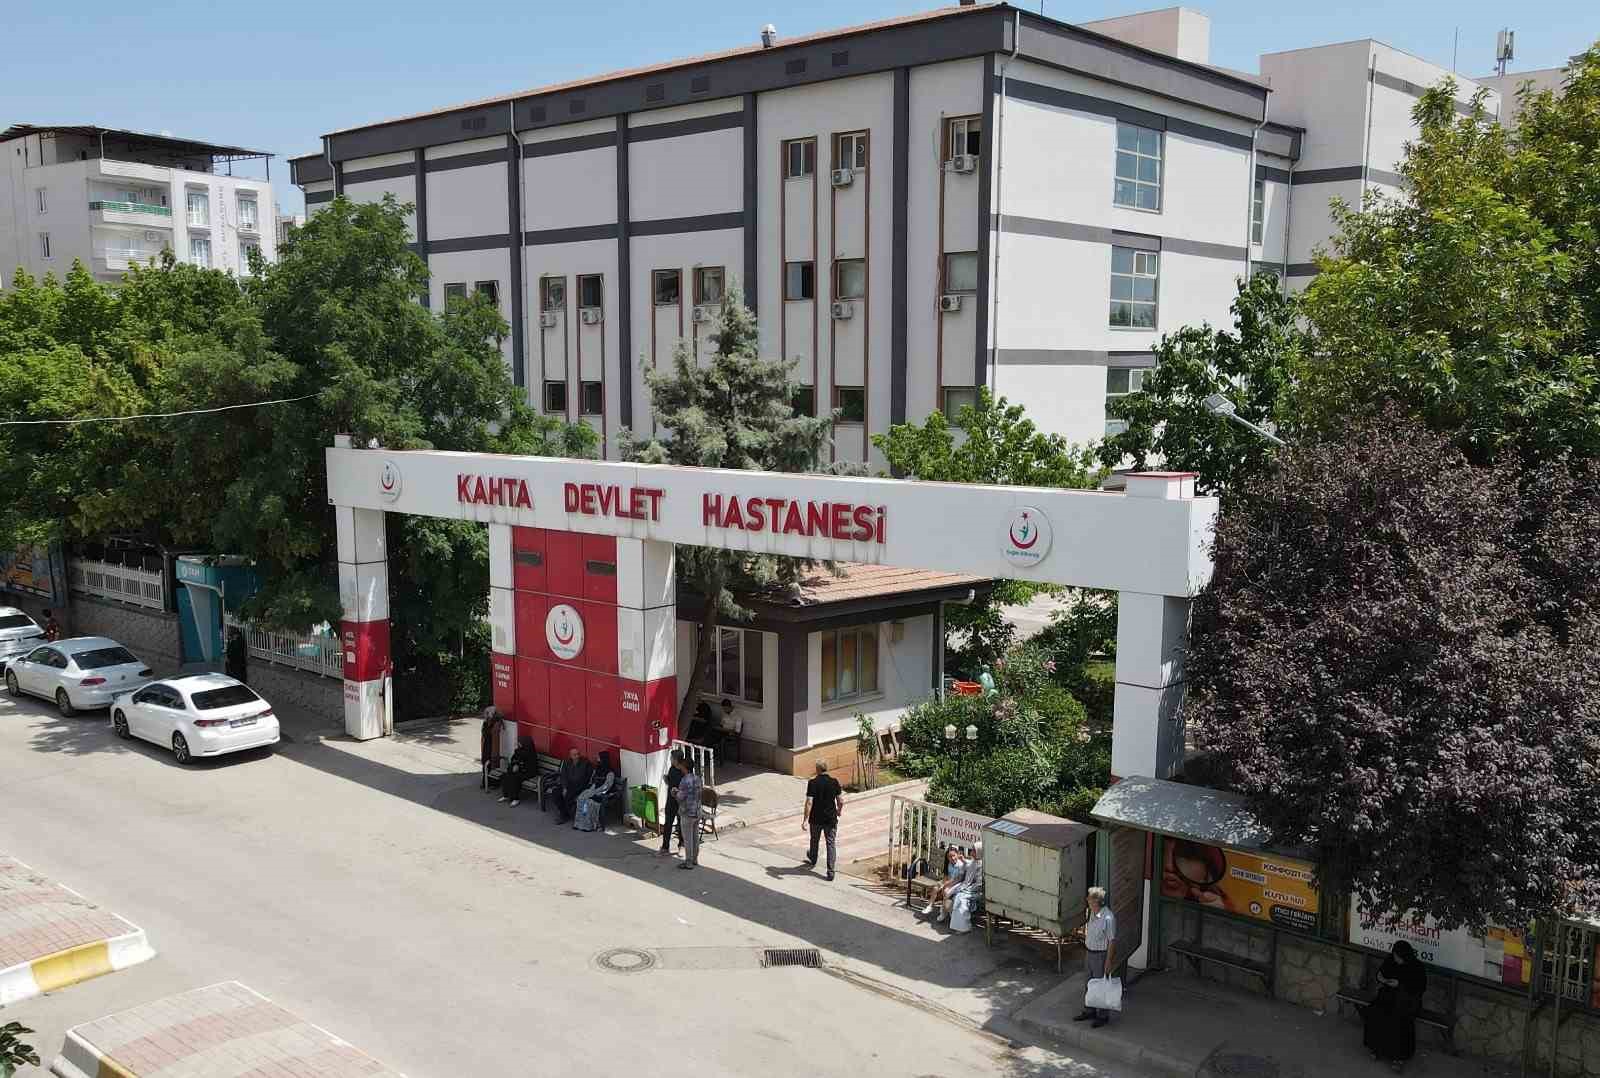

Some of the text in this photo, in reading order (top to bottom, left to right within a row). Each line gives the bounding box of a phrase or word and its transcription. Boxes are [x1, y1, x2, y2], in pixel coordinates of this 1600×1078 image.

[457, 474, 887, 544] KAHTA DEVLET HASTANESİ
[950, 816, 964, 828] OTO
